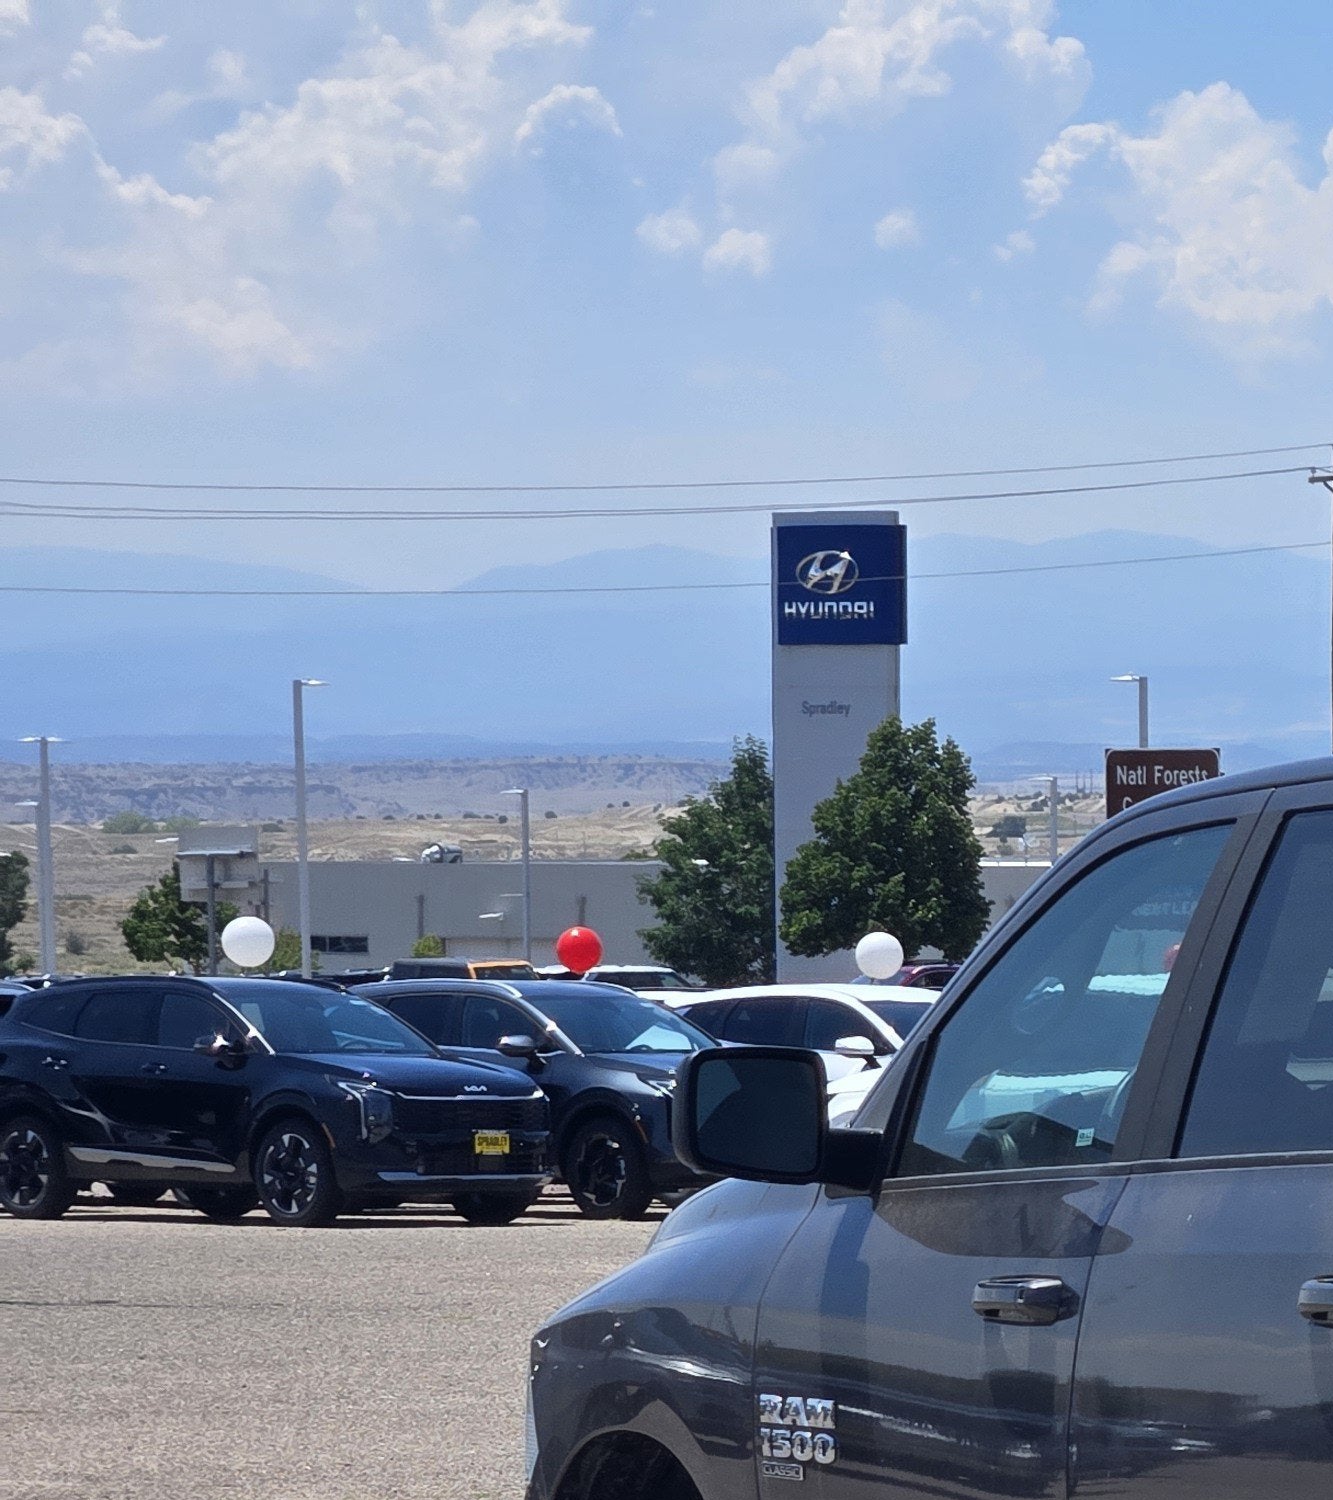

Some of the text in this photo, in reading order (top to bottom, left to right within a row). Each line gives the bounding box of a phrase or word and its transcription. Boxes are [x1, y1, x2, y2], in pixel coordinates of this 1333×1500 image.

[784, 601, 875, 620] HYUNDAI
[801, 701, 850, 717] Spradley
[1116, 765, 1208, 785] Natl Forests
[760, 1394, 835, 1429] RAM
[760, 1427, 835, 1464] 1500
